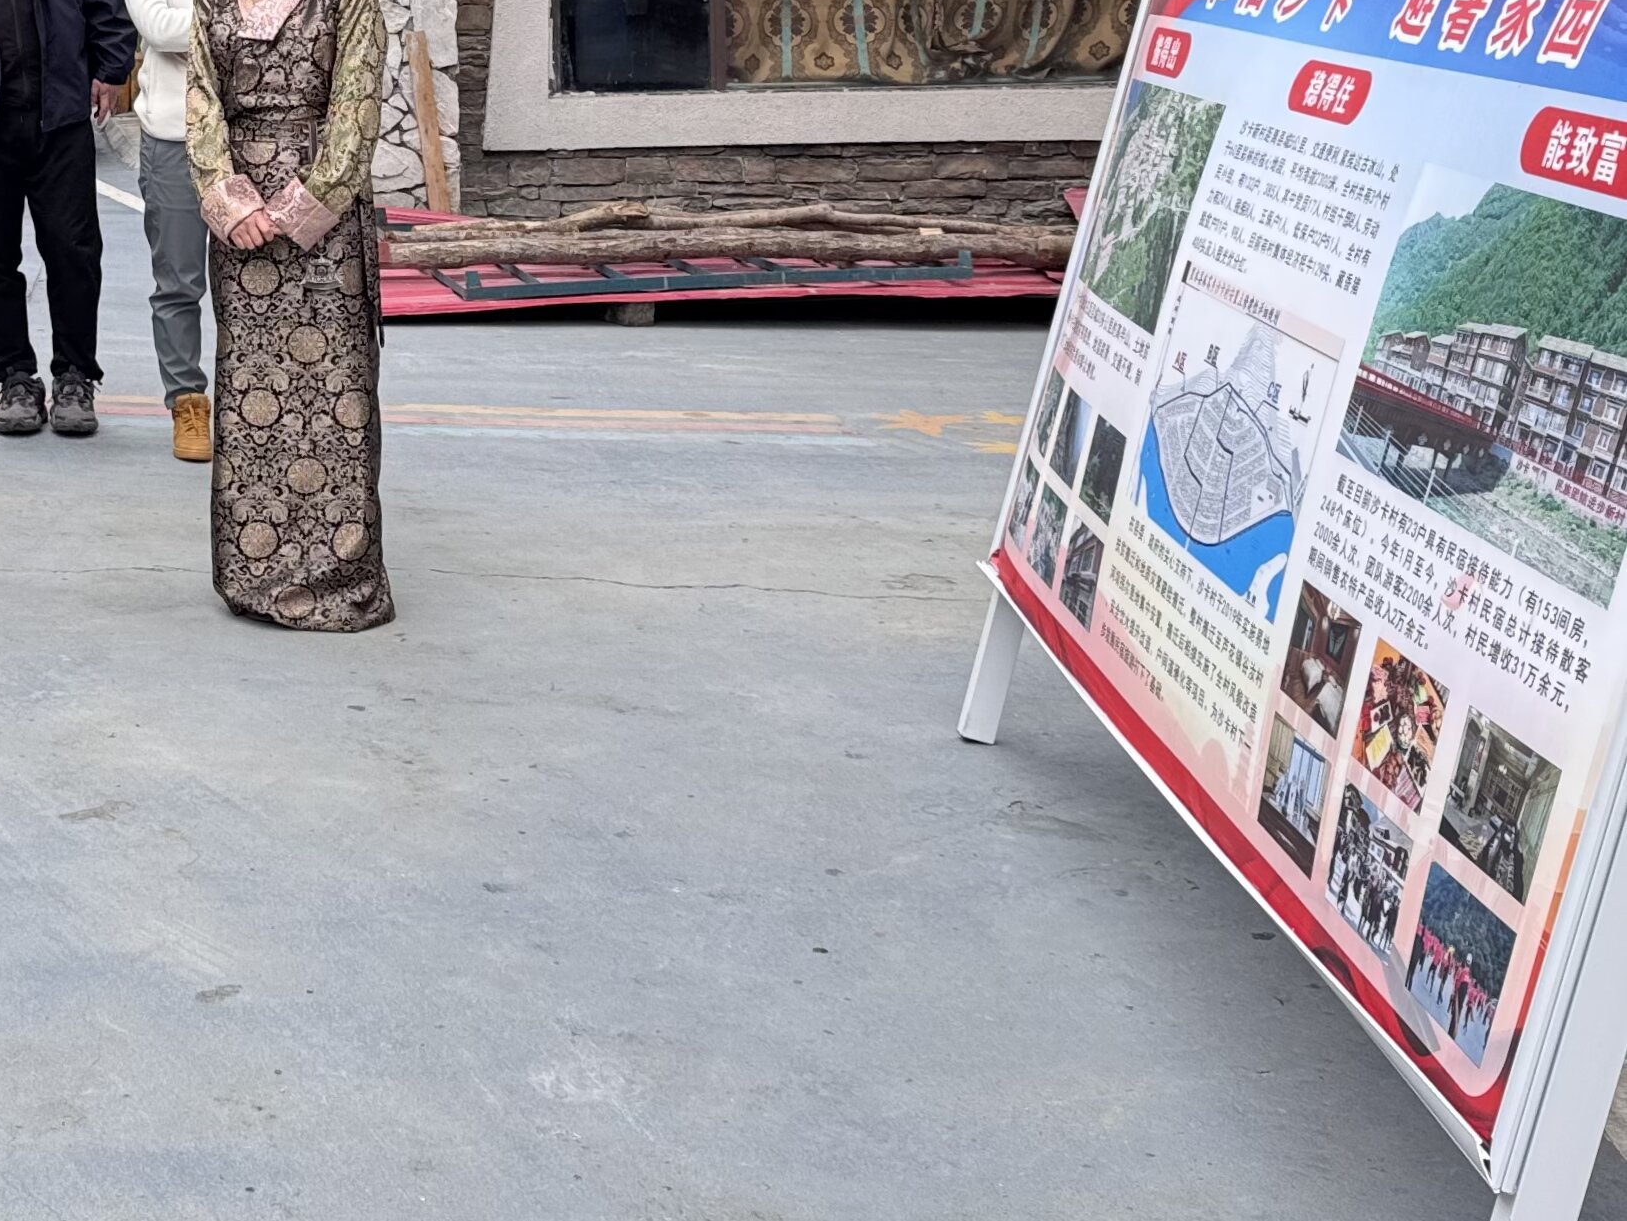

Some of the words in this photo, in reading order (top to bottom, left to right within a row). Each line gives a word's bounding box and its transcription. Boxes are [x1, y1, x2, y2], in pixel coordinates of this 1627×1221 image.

[1303, 70, 1357, 116] 稳得住
[1540, 118, 1627, 186] 能致富
